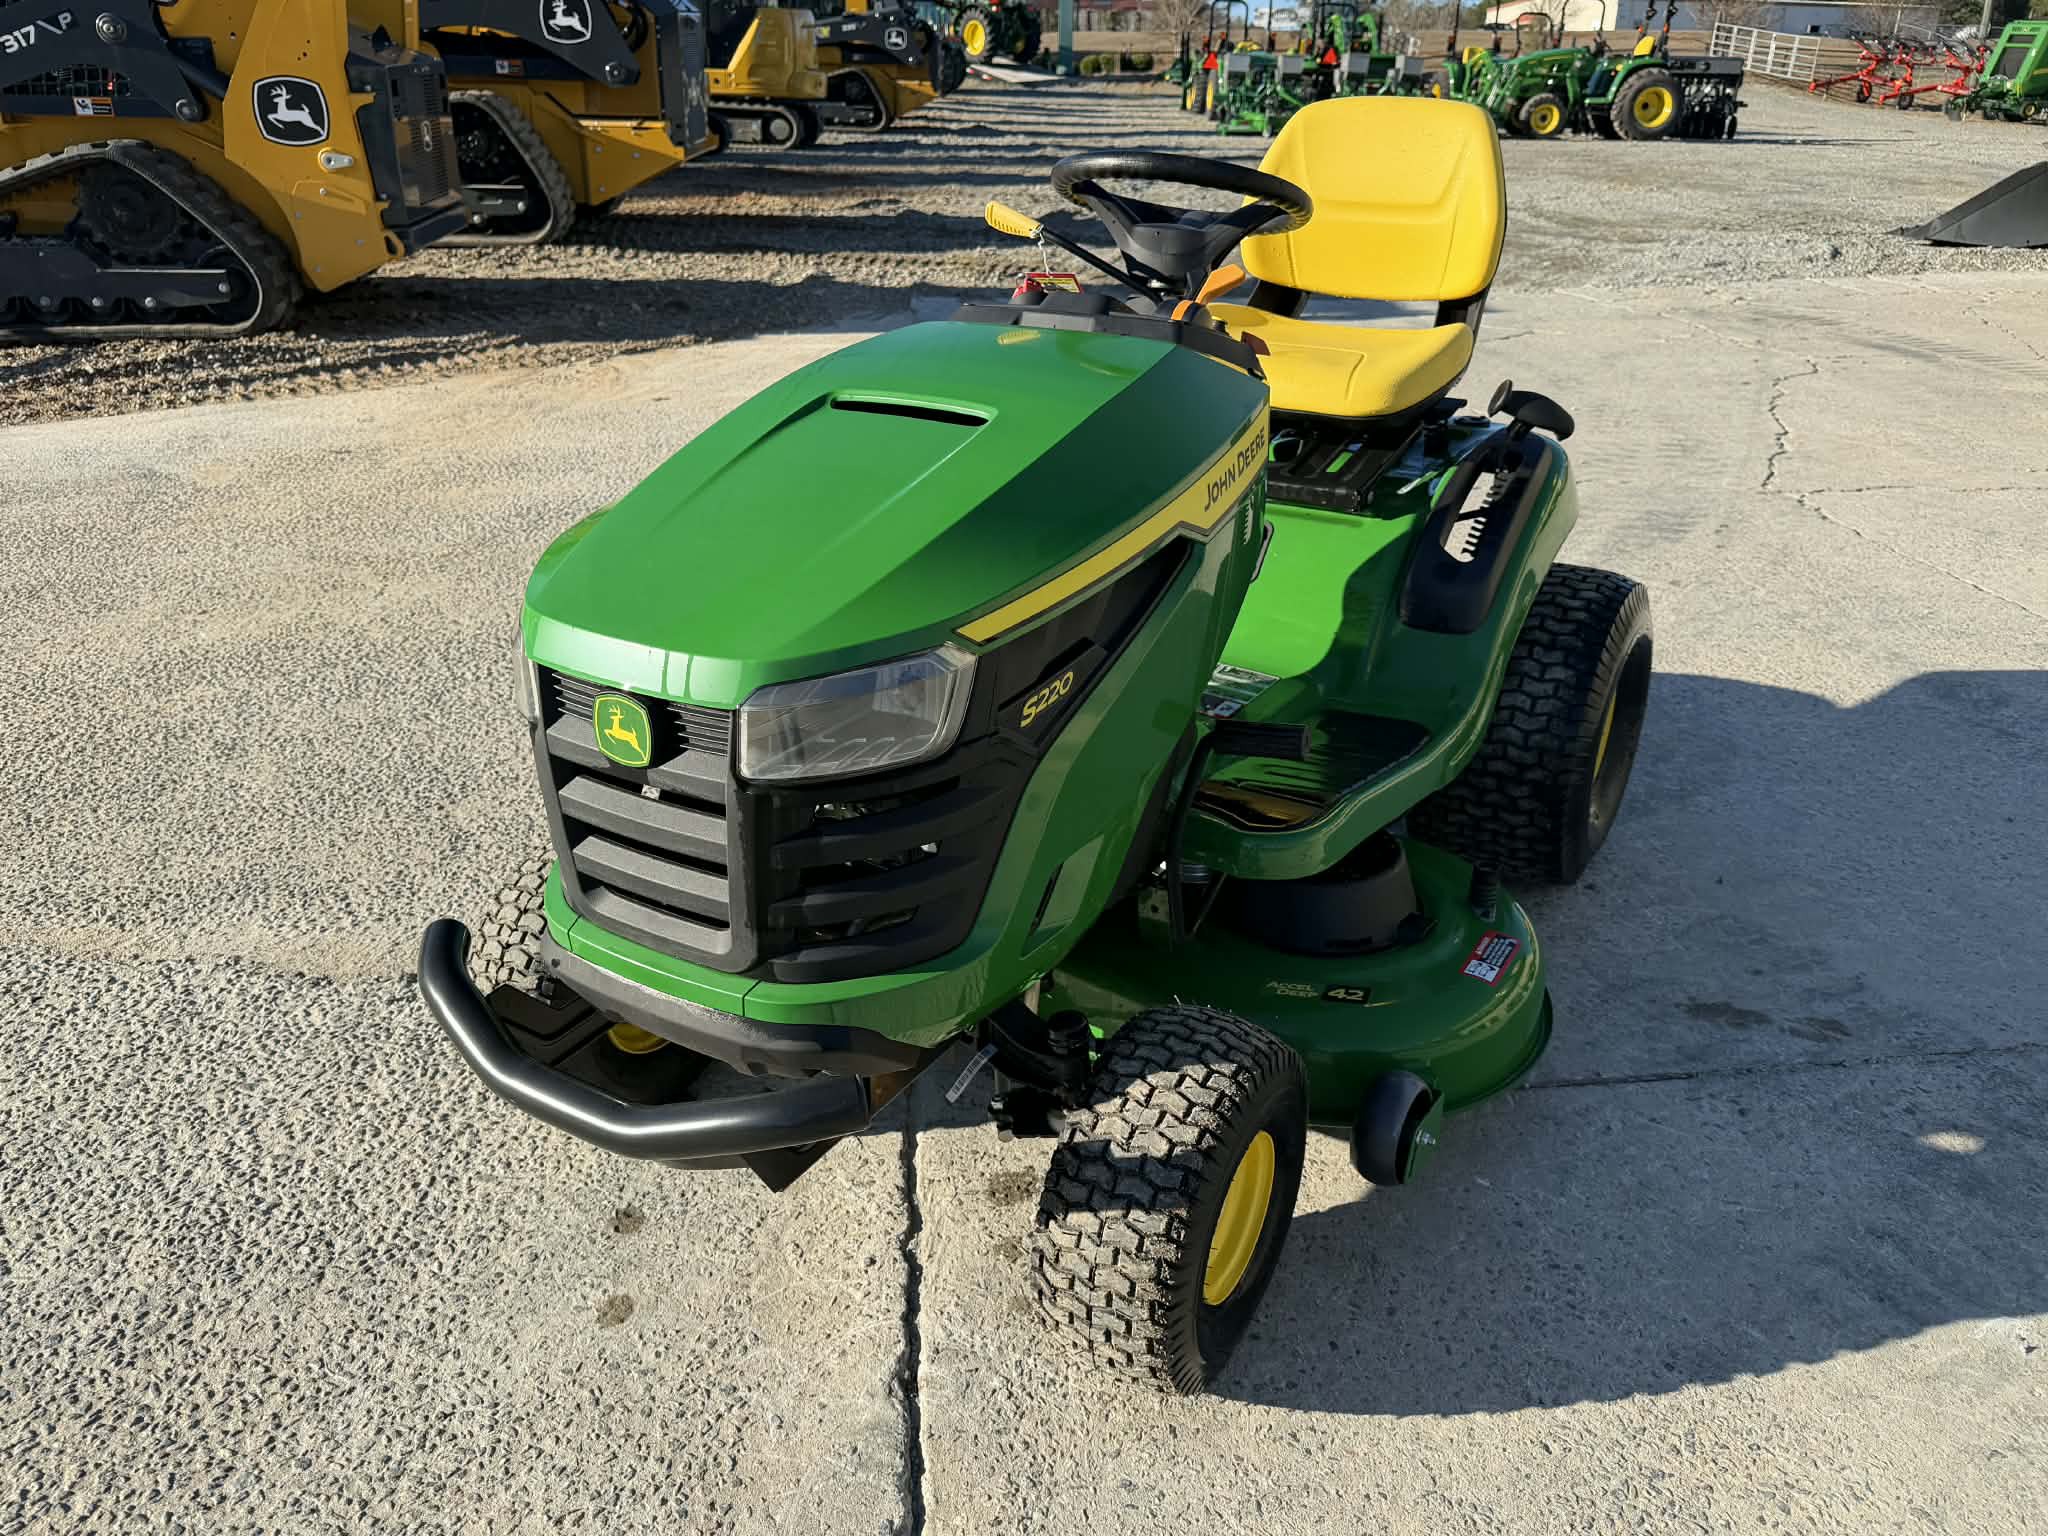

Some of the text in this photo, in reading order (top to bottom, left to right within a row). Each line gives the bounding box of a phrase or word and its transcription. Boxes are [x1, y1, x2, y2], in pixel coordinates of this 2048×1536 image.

[0, 24, 36, 53] 317
[1204, 426, 1265, 512] JOHN DEERE
[1020, 671, 1074, 728] S220
[1327, 988, 1366, 1001] 42
